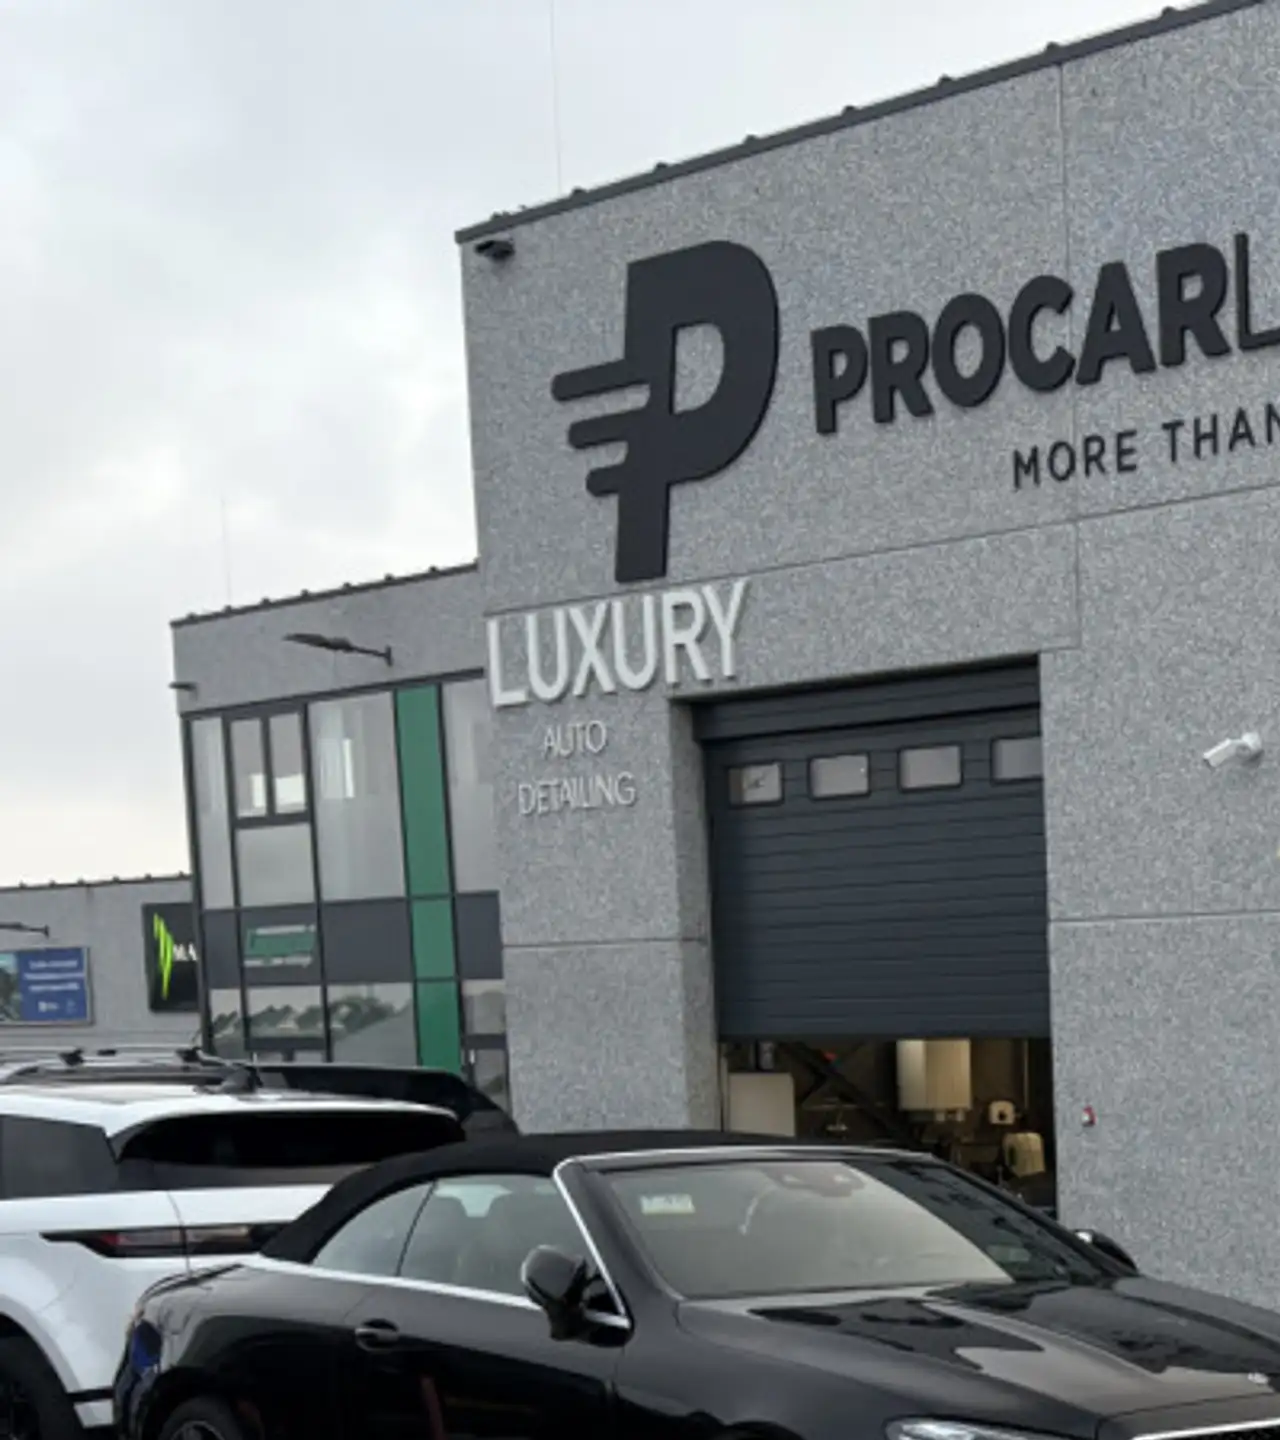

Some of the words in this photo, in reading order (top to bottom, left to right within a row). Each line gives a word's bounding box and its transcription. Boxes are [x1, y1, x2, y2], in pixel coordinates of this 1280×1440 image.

[1012, 429, 1138, 492] MORE
[487, 579, 750, 708] LUXURY
[543, 719, 609, 757] AUTO
[518, 771, 637, 816] DETAILING
